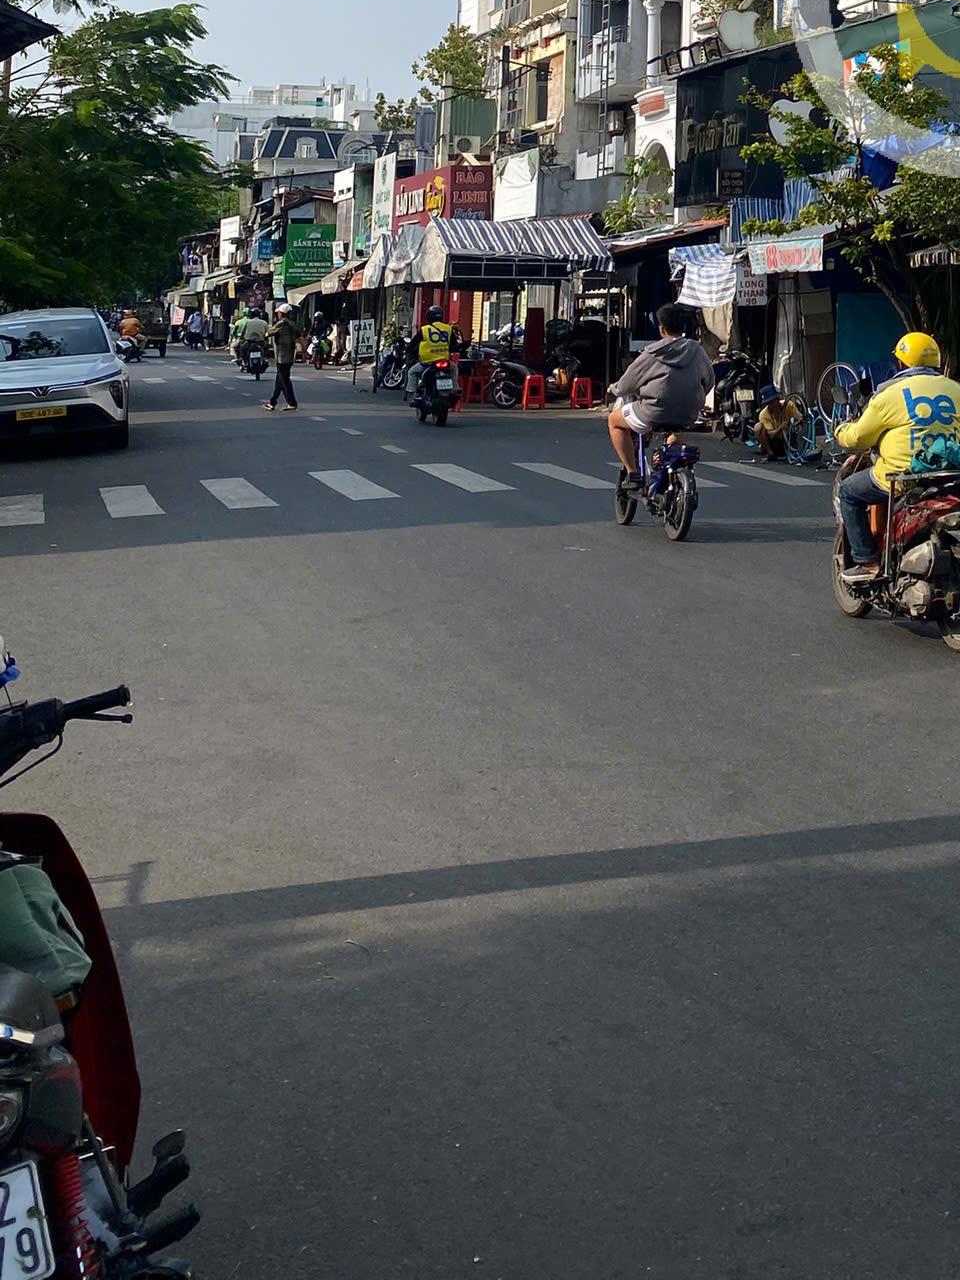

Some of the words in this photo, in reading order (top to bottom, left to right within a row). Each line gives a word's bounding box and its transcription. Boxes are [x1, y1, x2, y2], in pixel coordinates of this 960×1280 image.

[453, 190, 488, 203] LINH
[740, 280, 764, 288] LONG
[902, 387, 957, 427] be
